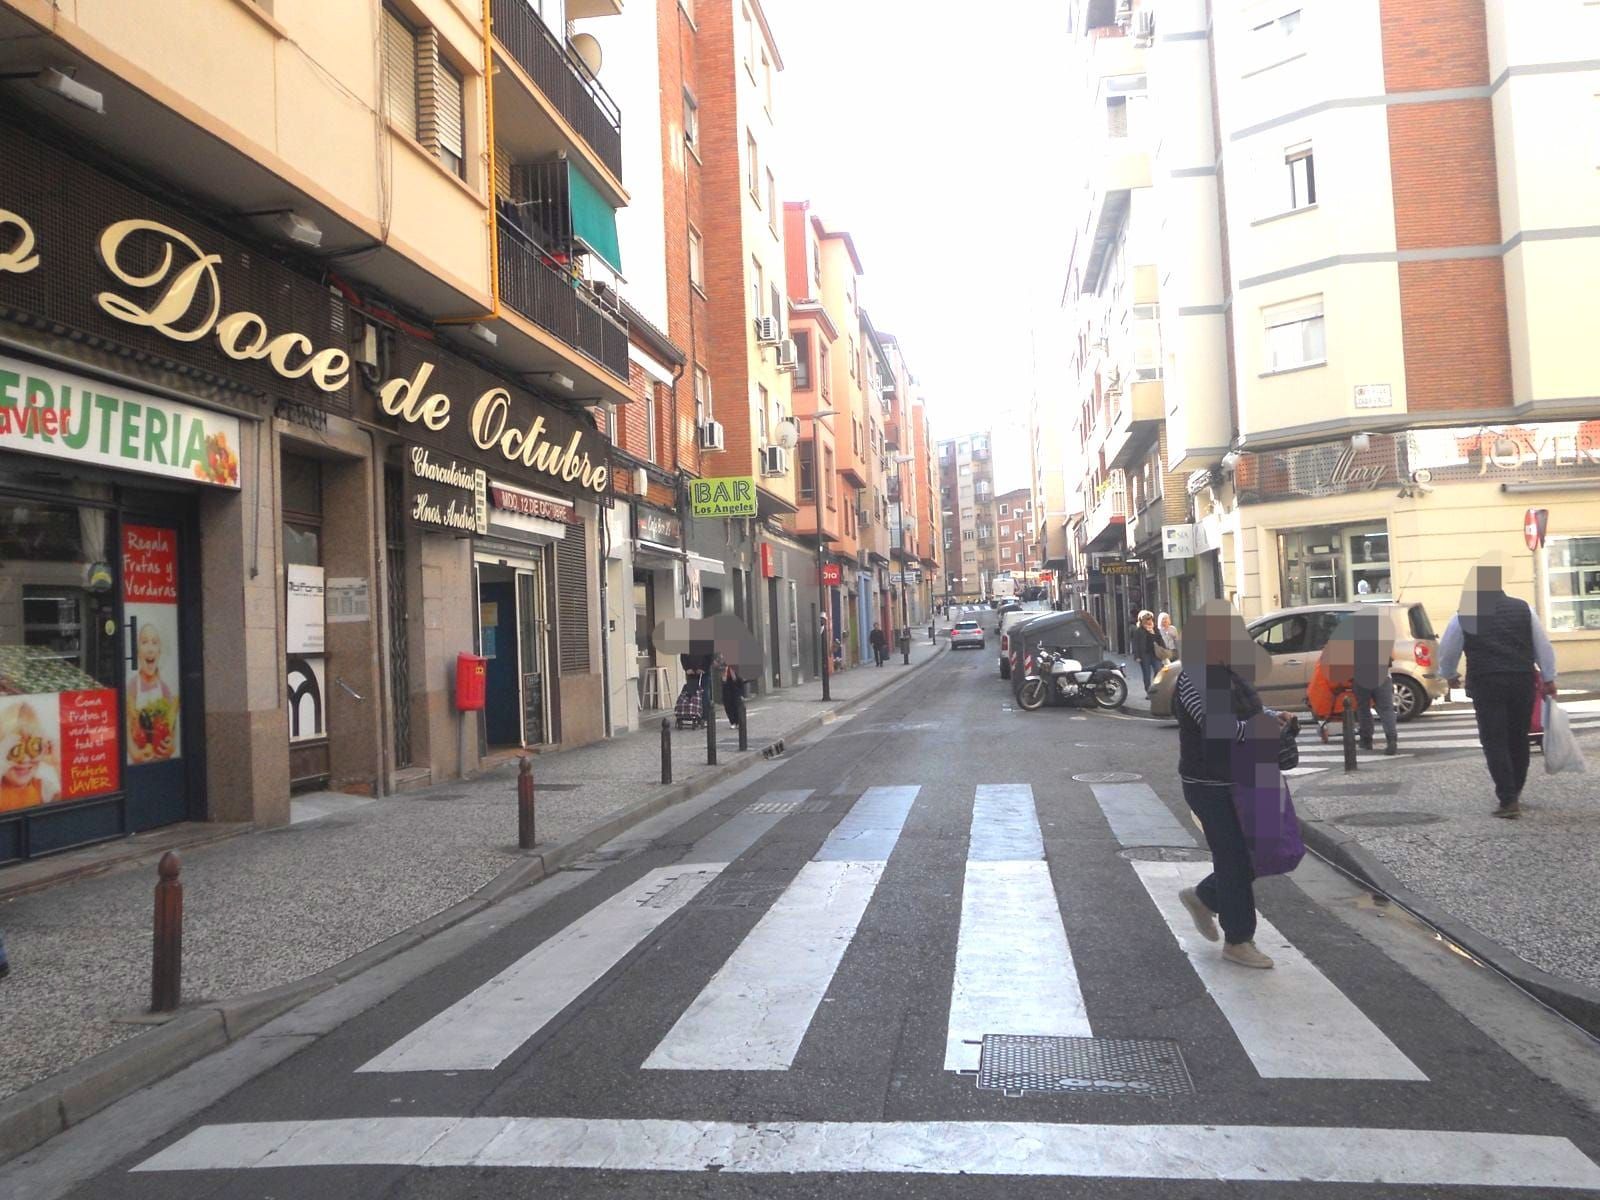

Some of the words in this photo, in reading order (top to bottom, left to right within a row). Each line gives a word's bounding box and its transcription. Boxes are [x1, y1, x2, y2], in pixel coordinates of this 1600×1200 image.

[97, 218, 350, 392] Doce
[379, 361, 451, 431] de
[470, 387, 608, 493] Octubre
[0, 369, 210, 470] FRUTERIA
[694, 480, 751, 504] BAR
[520, 497, 529, 513] 12
[529, 498, 539, 514] DE
[694, 505, 711, 514] Los
[714, 503, 753, 514] Angeles
[127, 531, 169, 557] Regala
[122, 554, 161, 574] Frutas
[166, 562, 173, 582] y
[124, 575, 177, 598] Verduras
[68, 777, 113, 794] JAVIER
